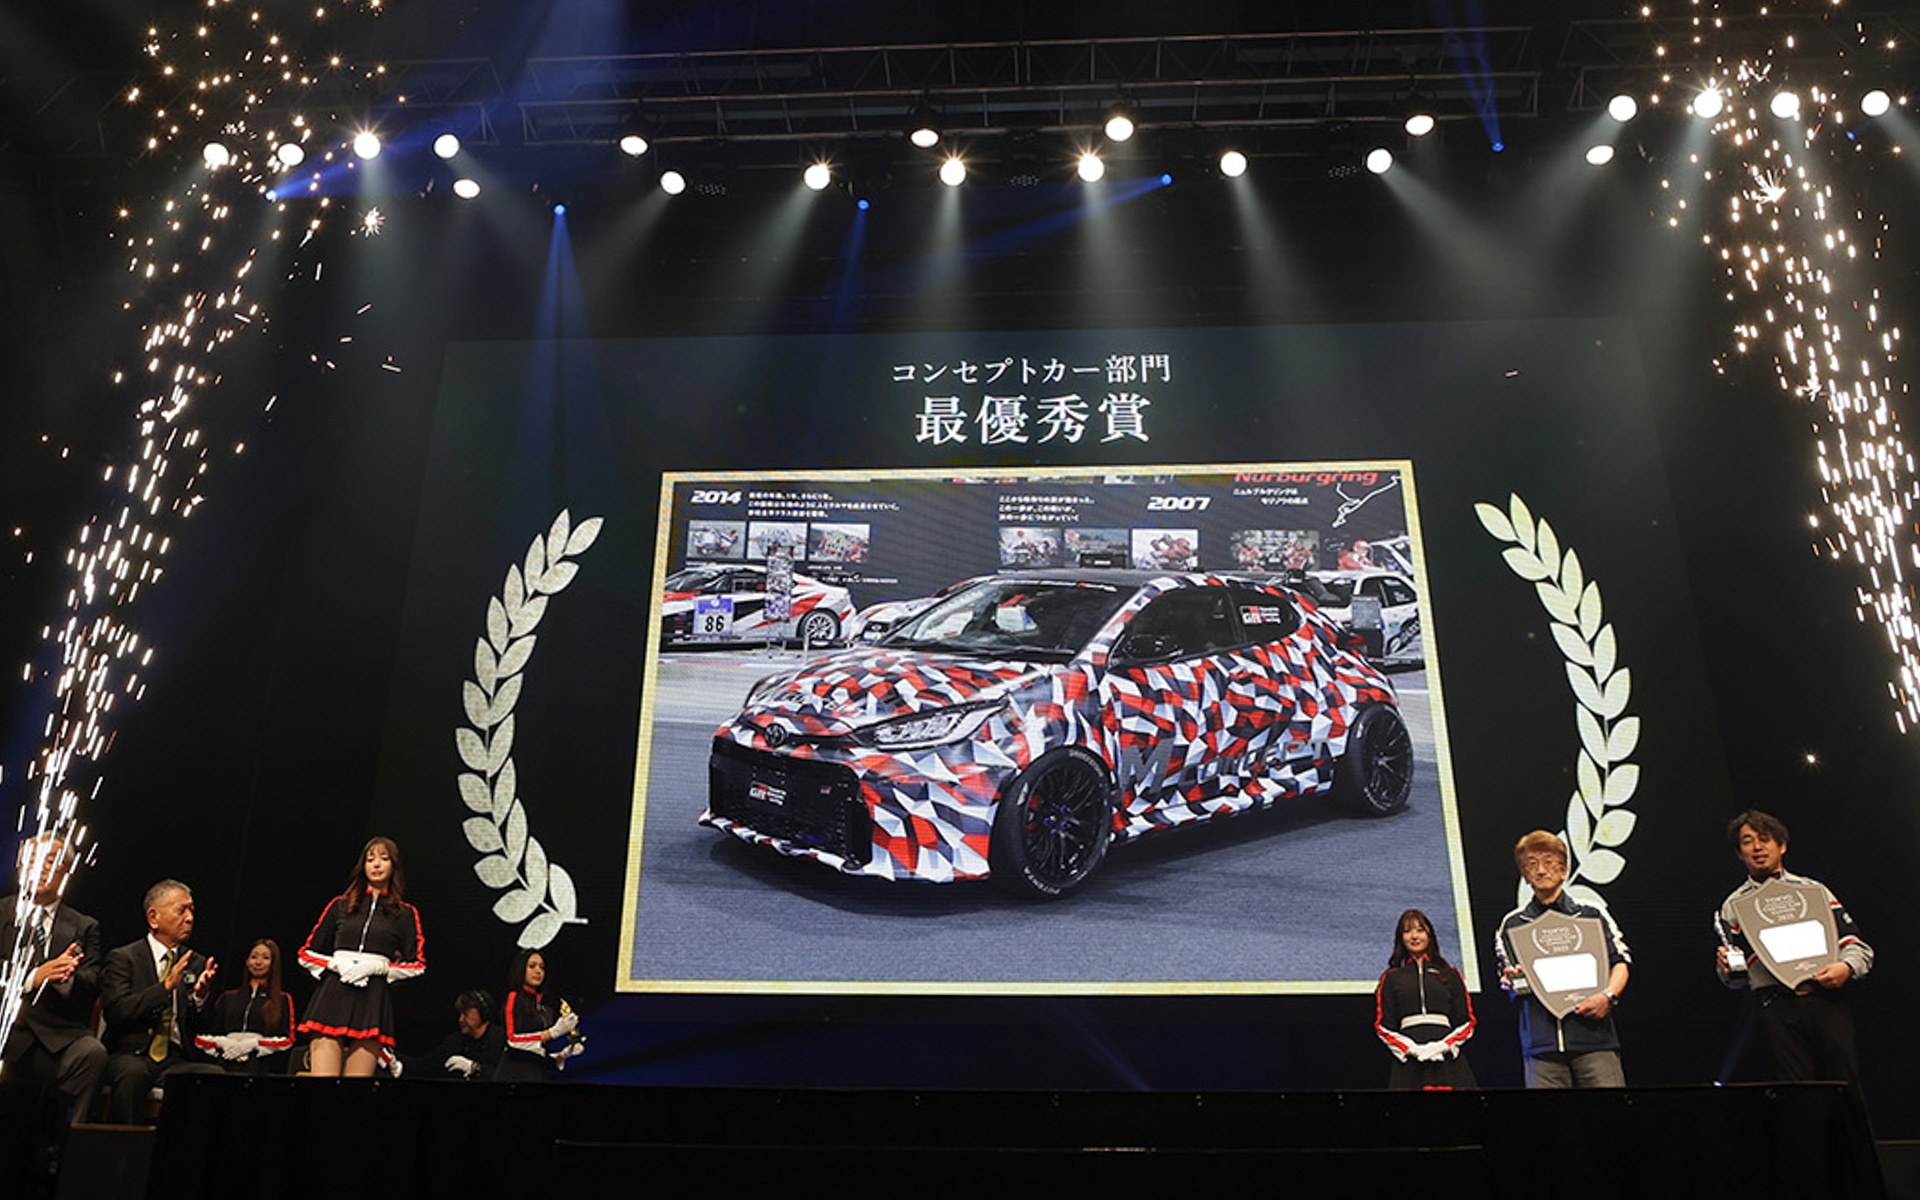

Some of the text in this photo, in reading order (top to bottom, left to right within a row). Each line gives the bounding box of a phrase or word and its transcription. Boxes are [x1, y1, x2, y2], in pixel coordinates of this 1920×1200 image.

[893, 354, 1171, 383] コンセプトカー部門
[915, 392, 1151, 445] 最優秀賞
[690, 490, 743, 504] 2014
[1147, 496, 1212, 511] 2007
[705, 615, 724, 632] 86
[1120, 738, 1174, 790] M
